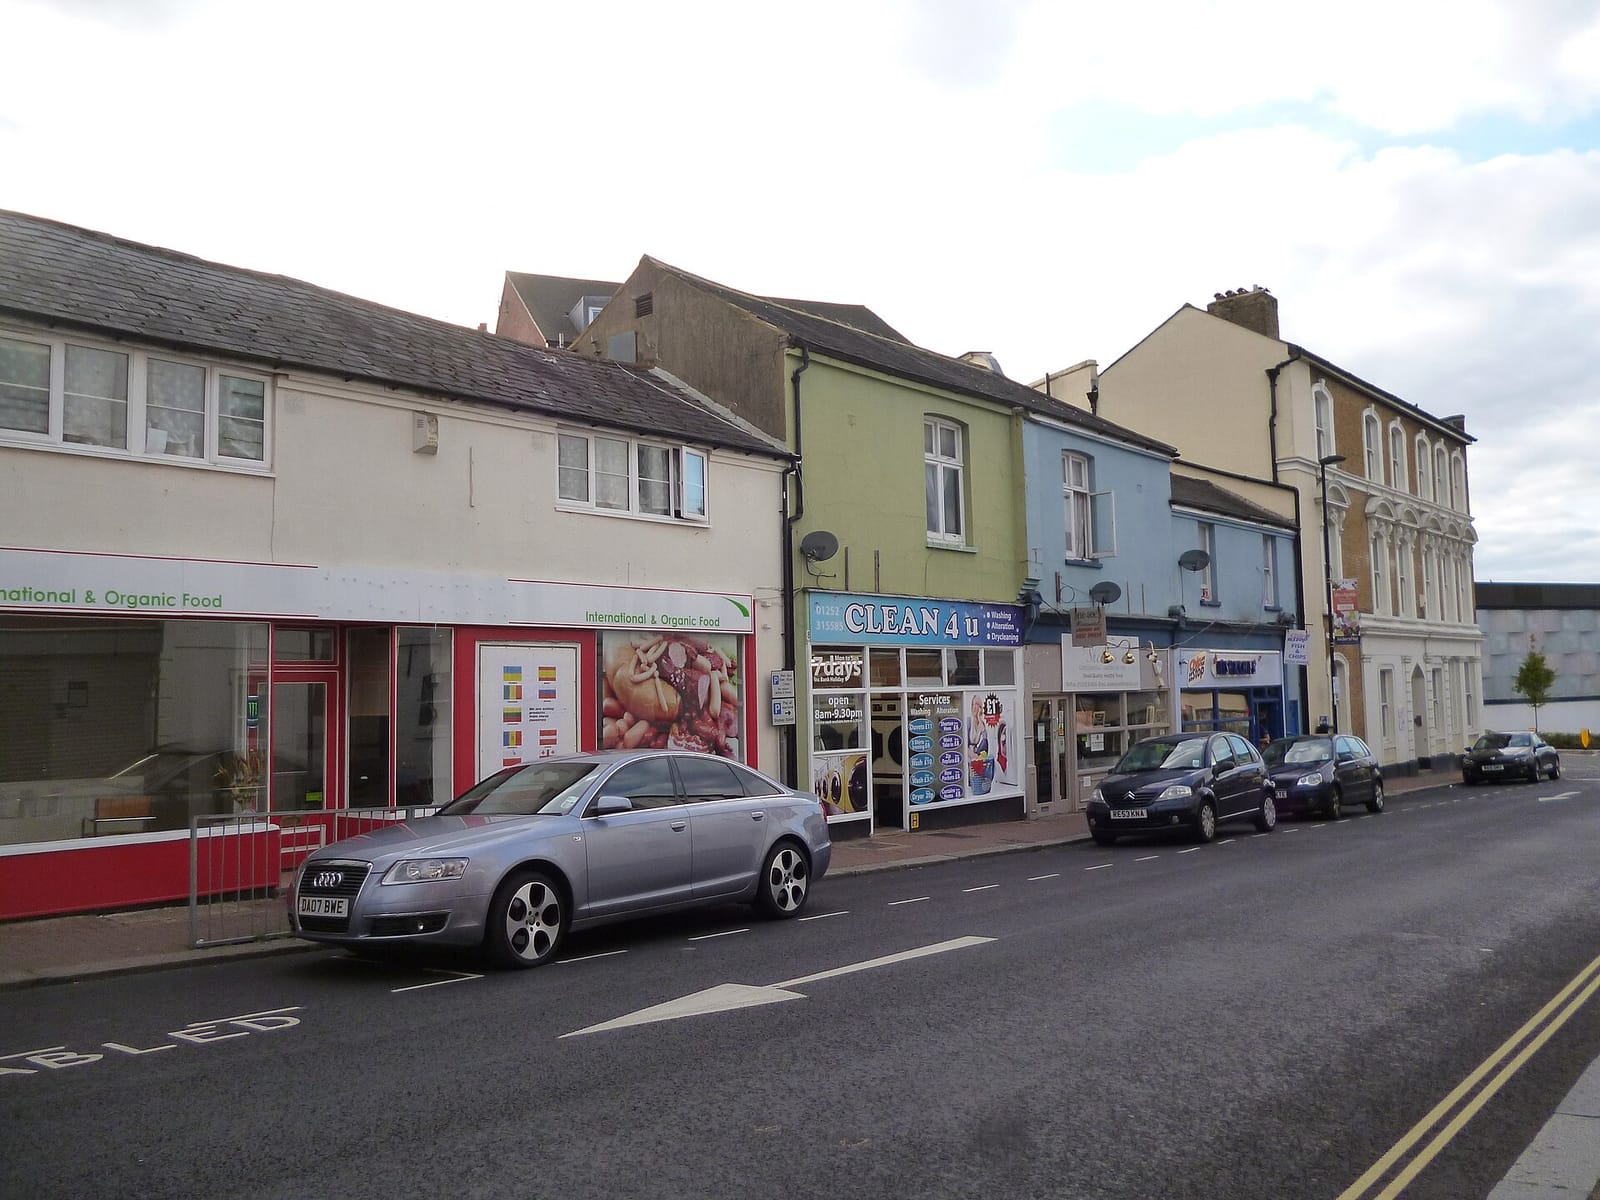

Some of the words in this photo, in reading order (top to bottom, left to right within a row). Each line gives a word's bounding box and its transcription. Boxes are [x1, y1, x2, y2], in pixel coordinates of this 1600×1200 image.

[0, 586, 76, 604] national
[85, 590, 96, 604] &
[105, 590, 176, 608] Organic
[182, 593, 222, 608] Food
[815, 604, 840, 616] 01252
[991, 610, 1012, 621] Washing
[585, 610, 647, 624] International
[650, 614, 657, 625] &
[661, 614, 697, 627] Organic
[699, 616, 720, 627] Food
[844, 602, 939, 636] CLEAN
[945, 612, 960, 640] 4
[965, 616, 980, 638] u
[991, 622, 1015, 630] Alteration
[991, 632, 1019, 642] Drycleaning
[828, 696, 849, 708] open
[919, 693, 951, 705] Services
[814, 708, 863, 720] 8am-9.30pm
[910, 706, 931, 716] Washing
[302, 898, 322, 913] DA07
[323, 900, 344, 914] BWE
